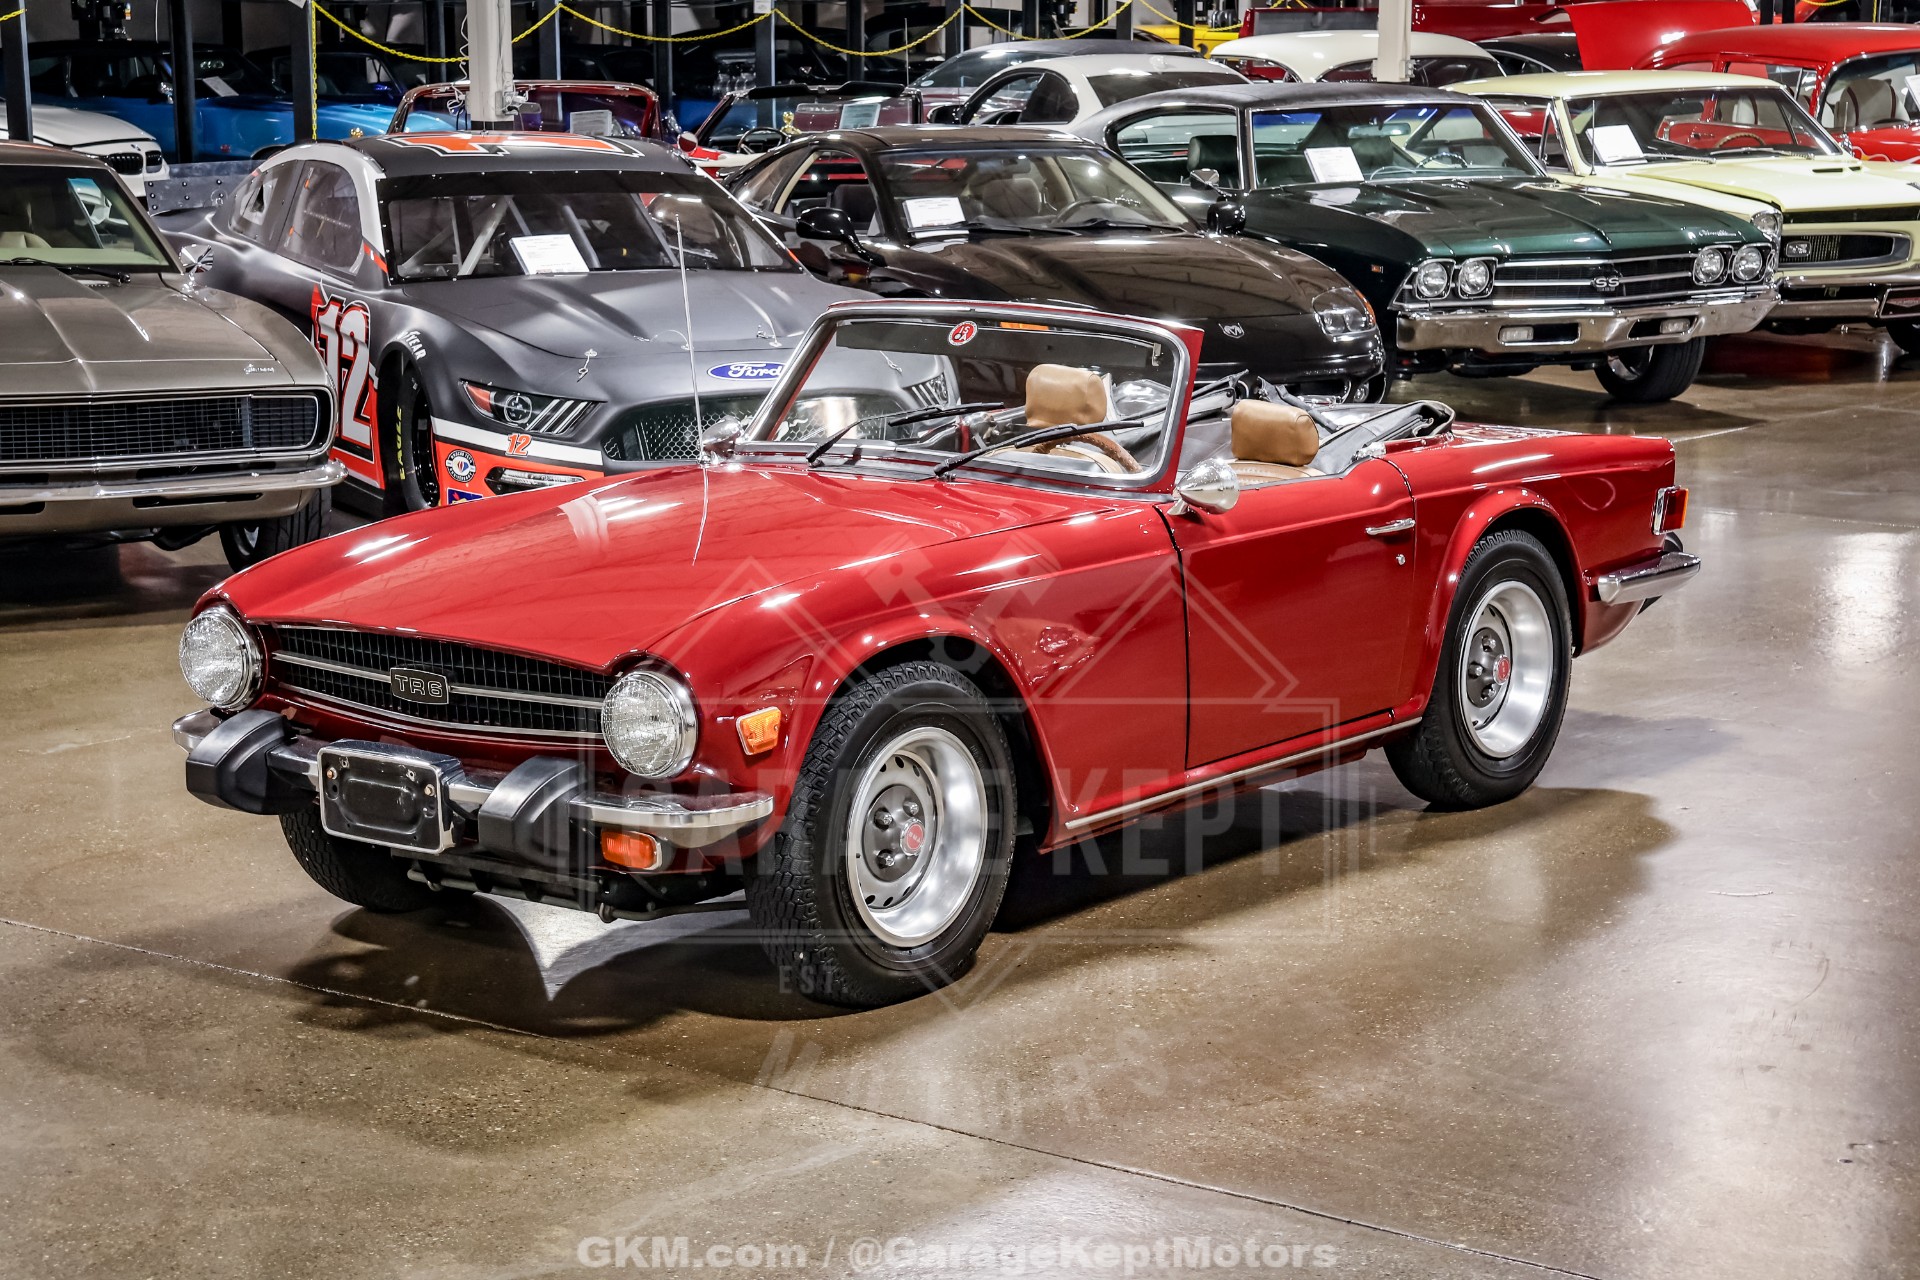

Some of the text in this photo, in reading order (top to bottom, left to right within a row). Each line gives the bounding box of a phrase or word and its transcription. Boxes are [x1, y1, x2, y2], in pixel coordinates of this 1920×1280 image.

[1595, 276, 1620, 288] SS
[316, 294, 373, 450] 12
[728, 363, 783, 377] Ford
[396, 405, 406, 481] EAGLE
[505, 432, 532, 457] 12
[394, 674, 442, 698] TR6
